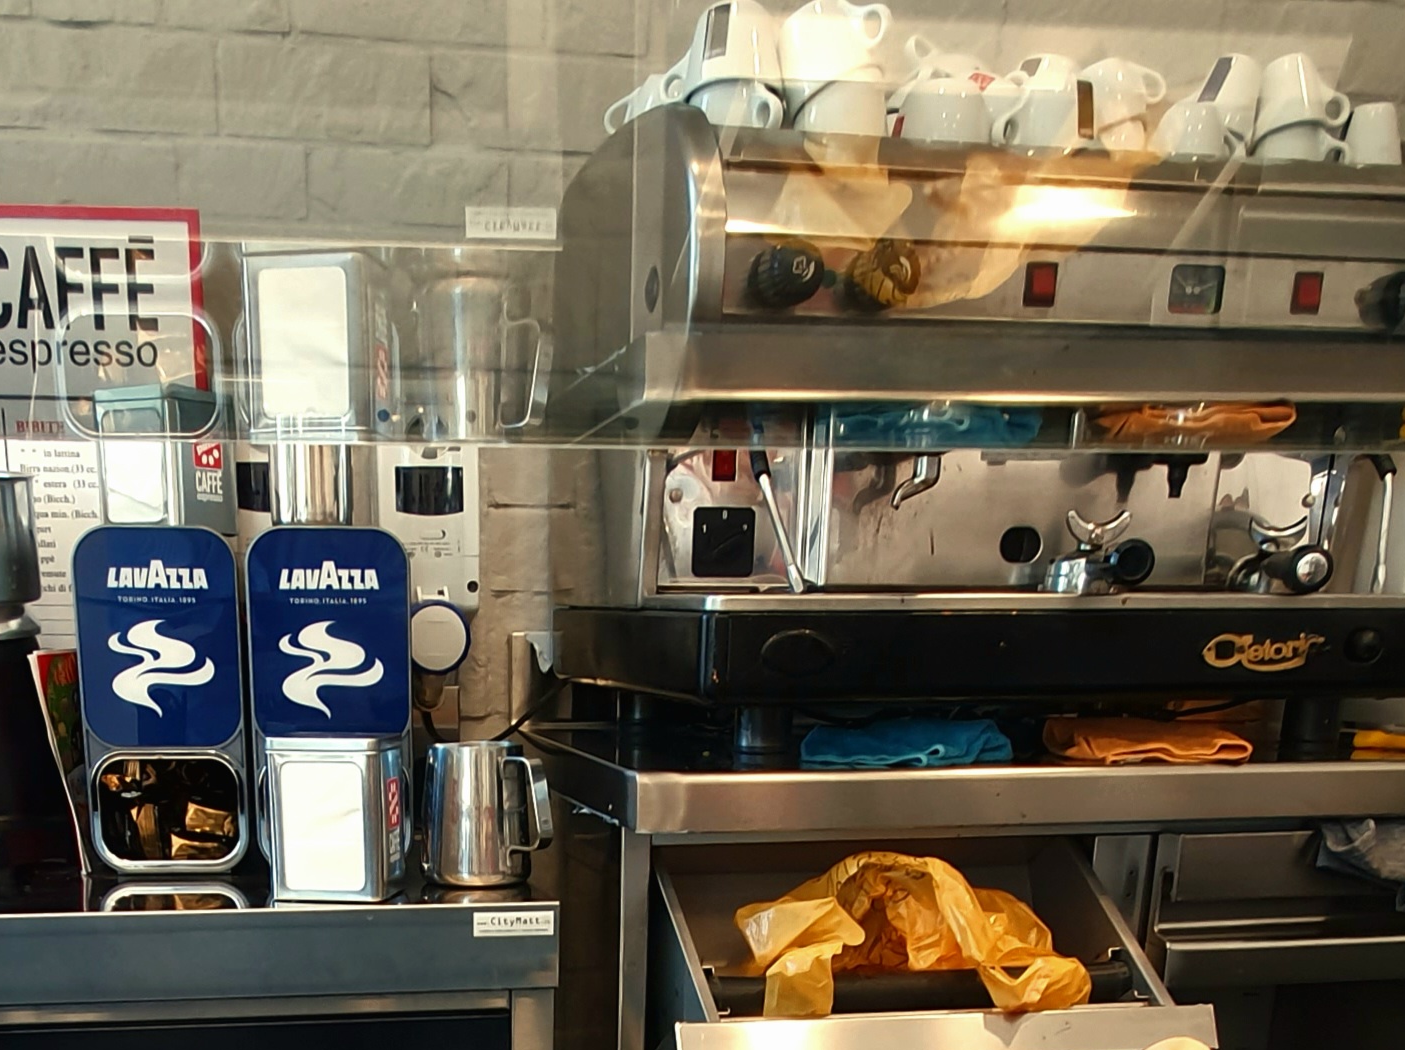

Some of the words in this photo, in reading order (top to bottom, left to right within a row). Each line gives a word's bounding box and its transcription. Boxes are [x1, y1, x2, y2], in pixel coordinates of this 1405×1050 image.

[106, 559, 209, 590] LAVAZZA
[278, 560, 380, 591] LAVAZZA
[490, 916, 540, 927] CityMatt
